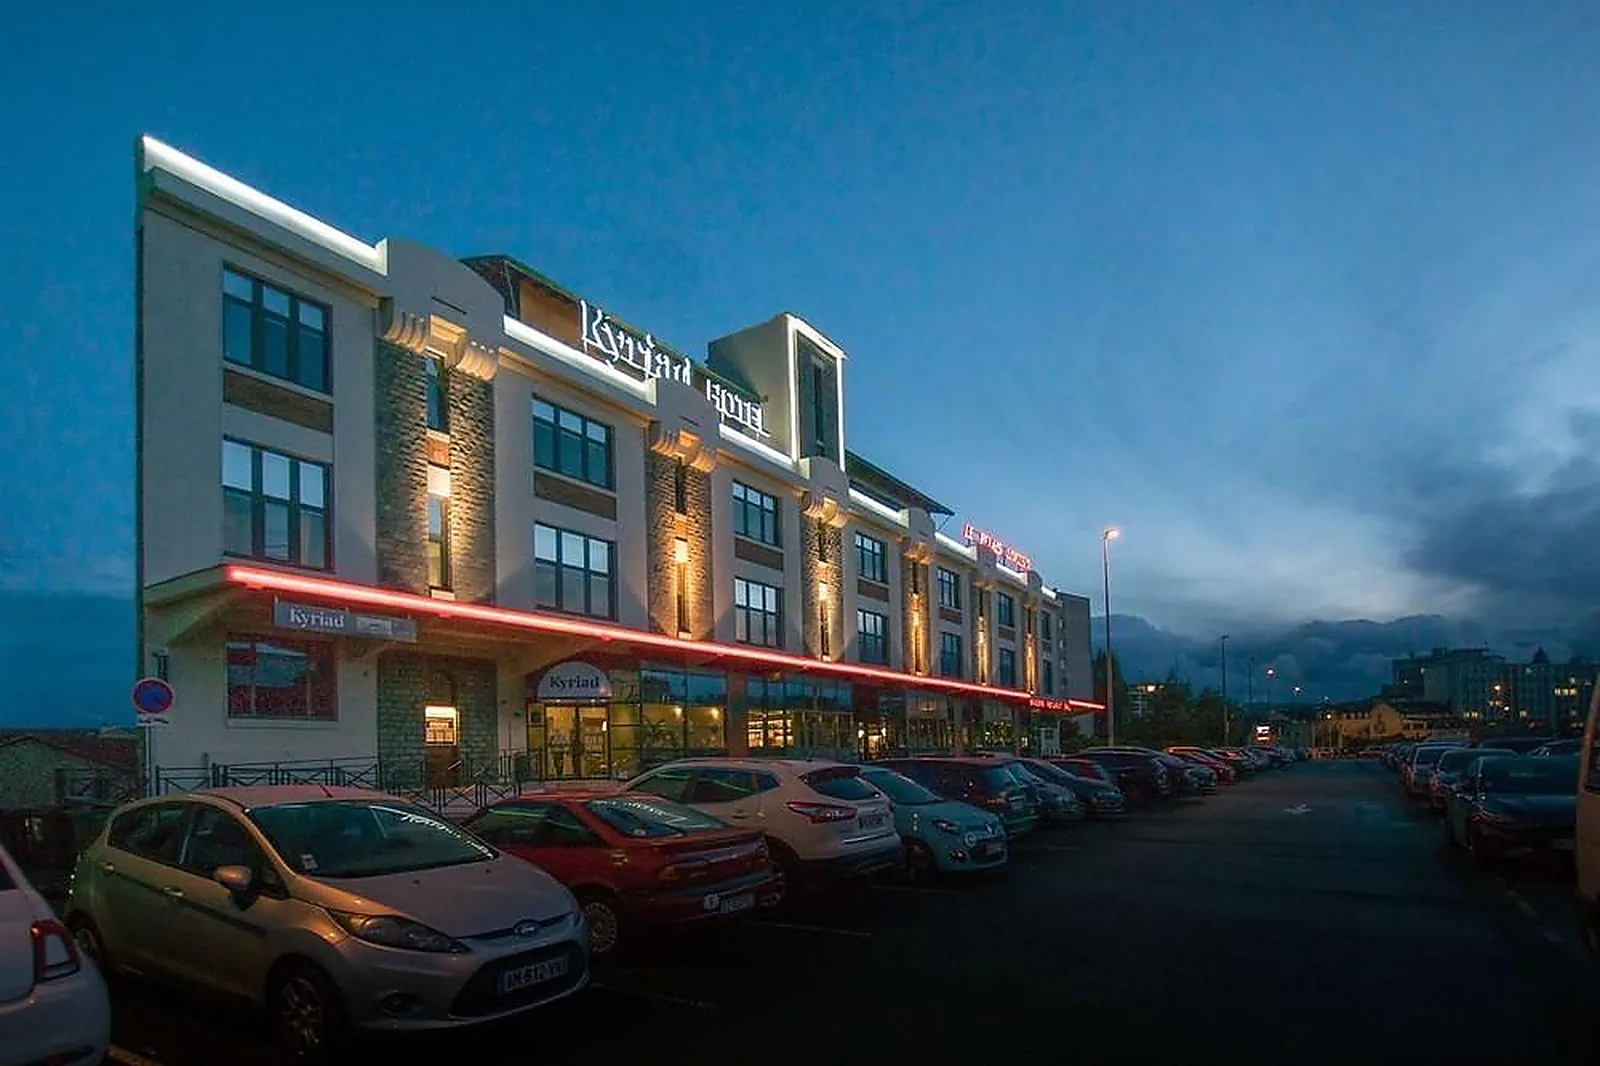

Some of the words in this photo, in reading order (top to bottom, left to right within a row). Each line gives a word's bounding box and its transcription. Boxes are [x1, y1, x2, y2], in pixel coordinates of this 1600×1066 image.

[580, 299, 691, 386] Kyriad
[289, 607, 345, 629] Kyriad
[549, 674, 600, 690] Kyriad
